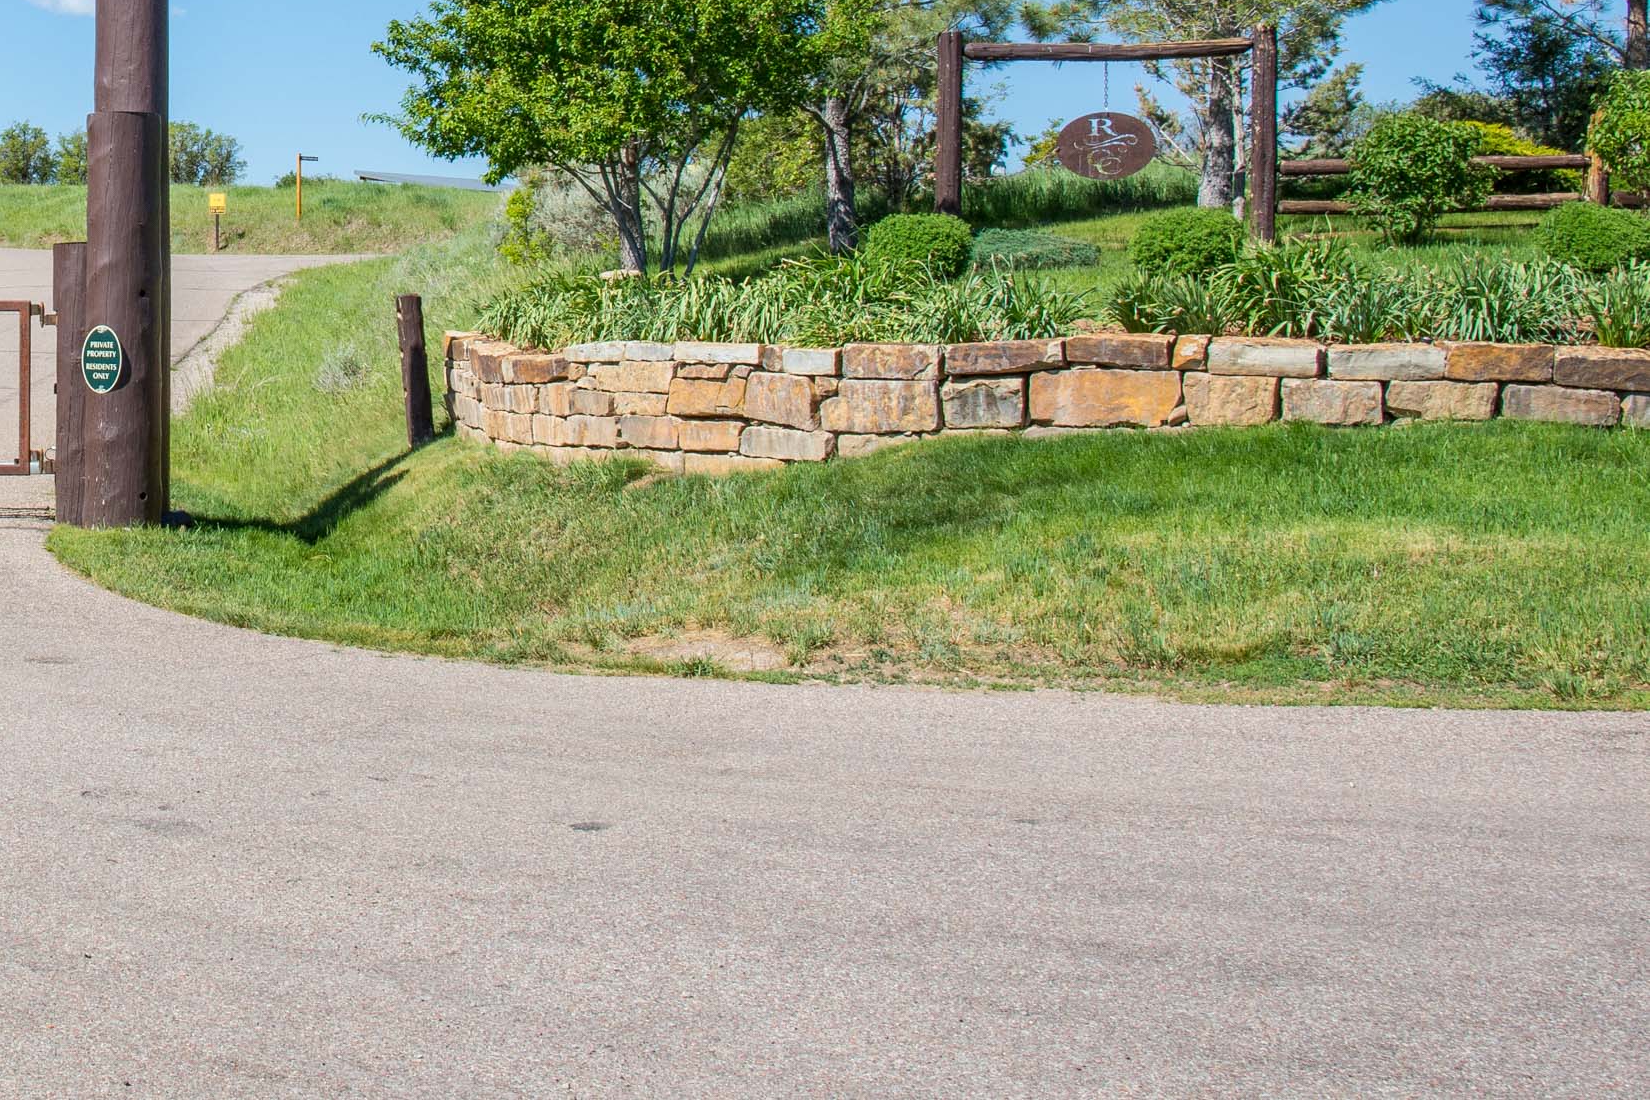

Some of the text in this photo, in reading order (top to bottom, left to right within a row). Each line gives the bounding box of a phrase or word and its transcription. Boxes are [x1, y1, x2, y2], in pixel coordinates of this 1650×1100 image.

[1087, 118, 1118, 137] R
[90, 341, 114, 349] PRIVATE
[86, 350, 117, 358] PROPERTY
[85, 363, 117, 371] RESIDENTS
[92, 372, 110, 380] ONLY
